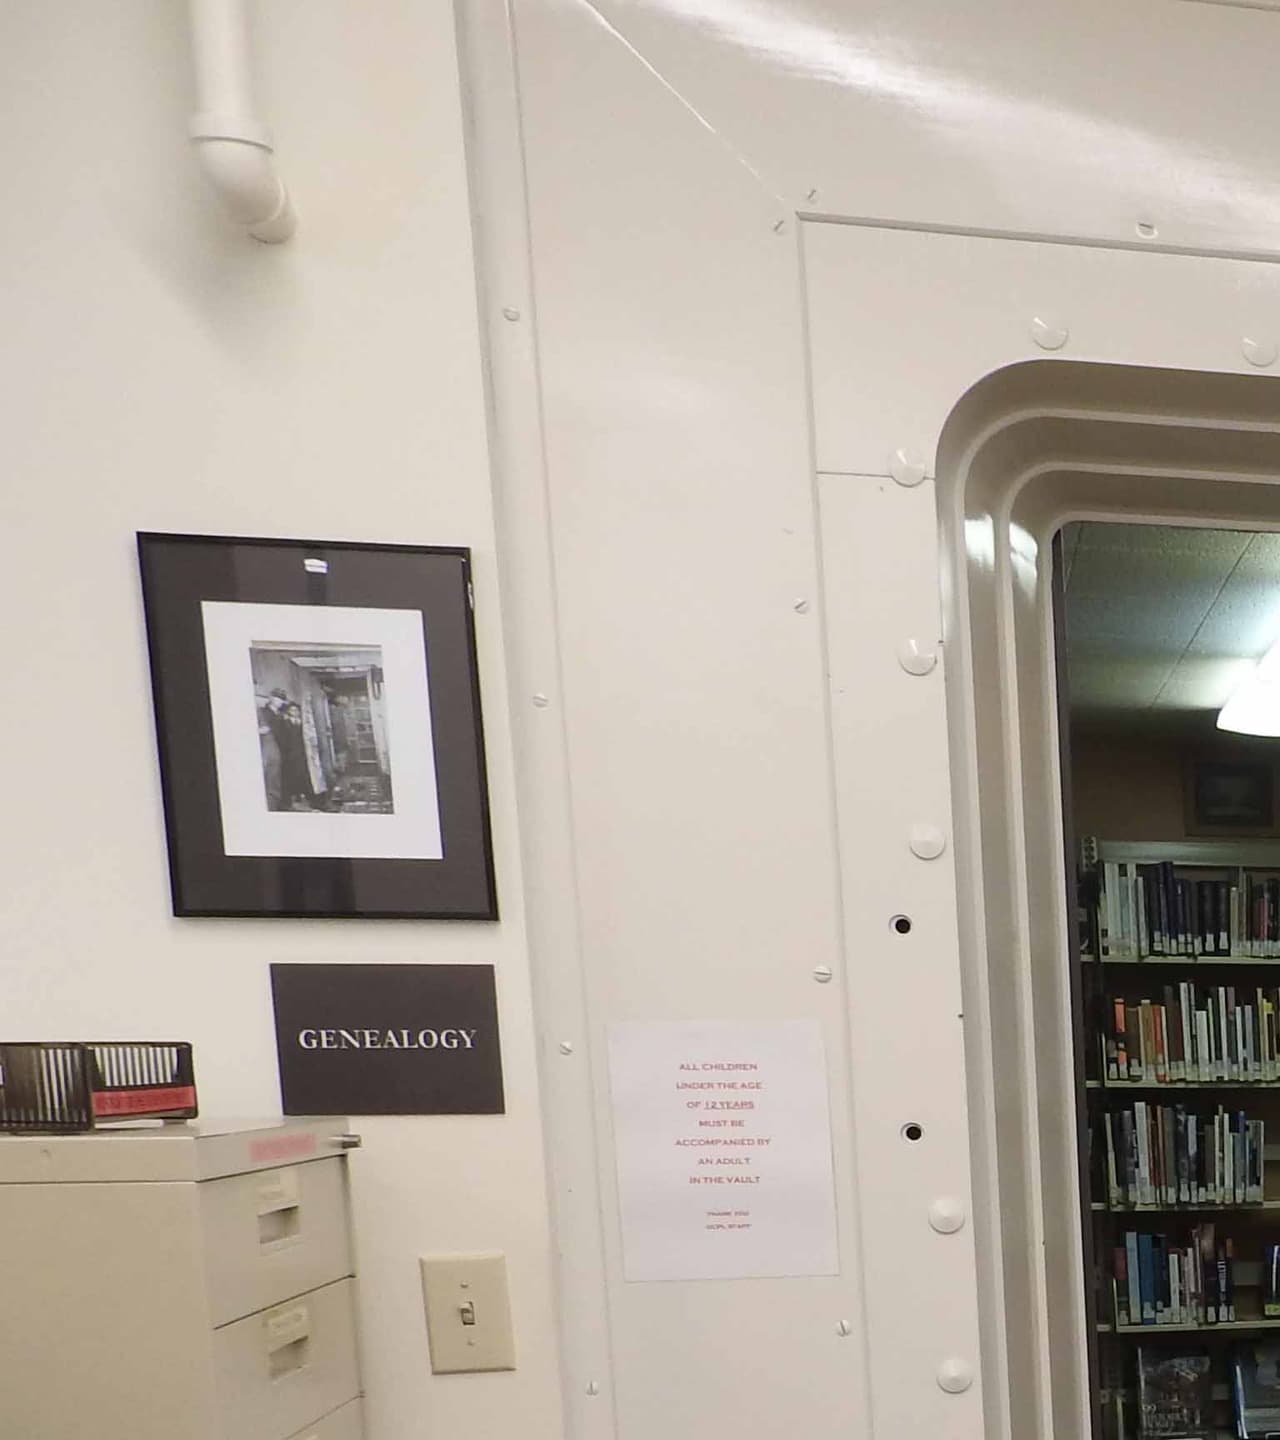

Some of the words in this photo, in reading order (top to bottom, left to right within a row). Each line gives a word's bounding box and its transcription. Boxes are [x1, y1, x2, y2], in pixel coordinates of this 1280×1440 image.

[298, 1029, 477, 1049] GENEALOGY
[679, 1063, 700, 1071] ALL
[702, 1063, 758, 1071] CHILDREN
[676, 1082, 716, 1090] UNDER
[716, 1082, 736, 1090] THE
[736, 1082, 762, 1090] AGE
[686, 1101, 701, 1109] OF
[704, 1101, 718, 1110] 12
[719, 1101, 755, 1110] YEARS
[698, 1120, 727, 1128] MUST
[730, 1120, 745, 1128] BE
[674, 1138, 755, 1147] ACCOMPANIED
[757, 1138, 771, 1146] BY
[716, 1157, 751, 1165] ADULT
[689, 1176, 701, 1184] IN
[702, 1176, 725, 1184] THE
[726, 1176, 761, 1184] VAULT
